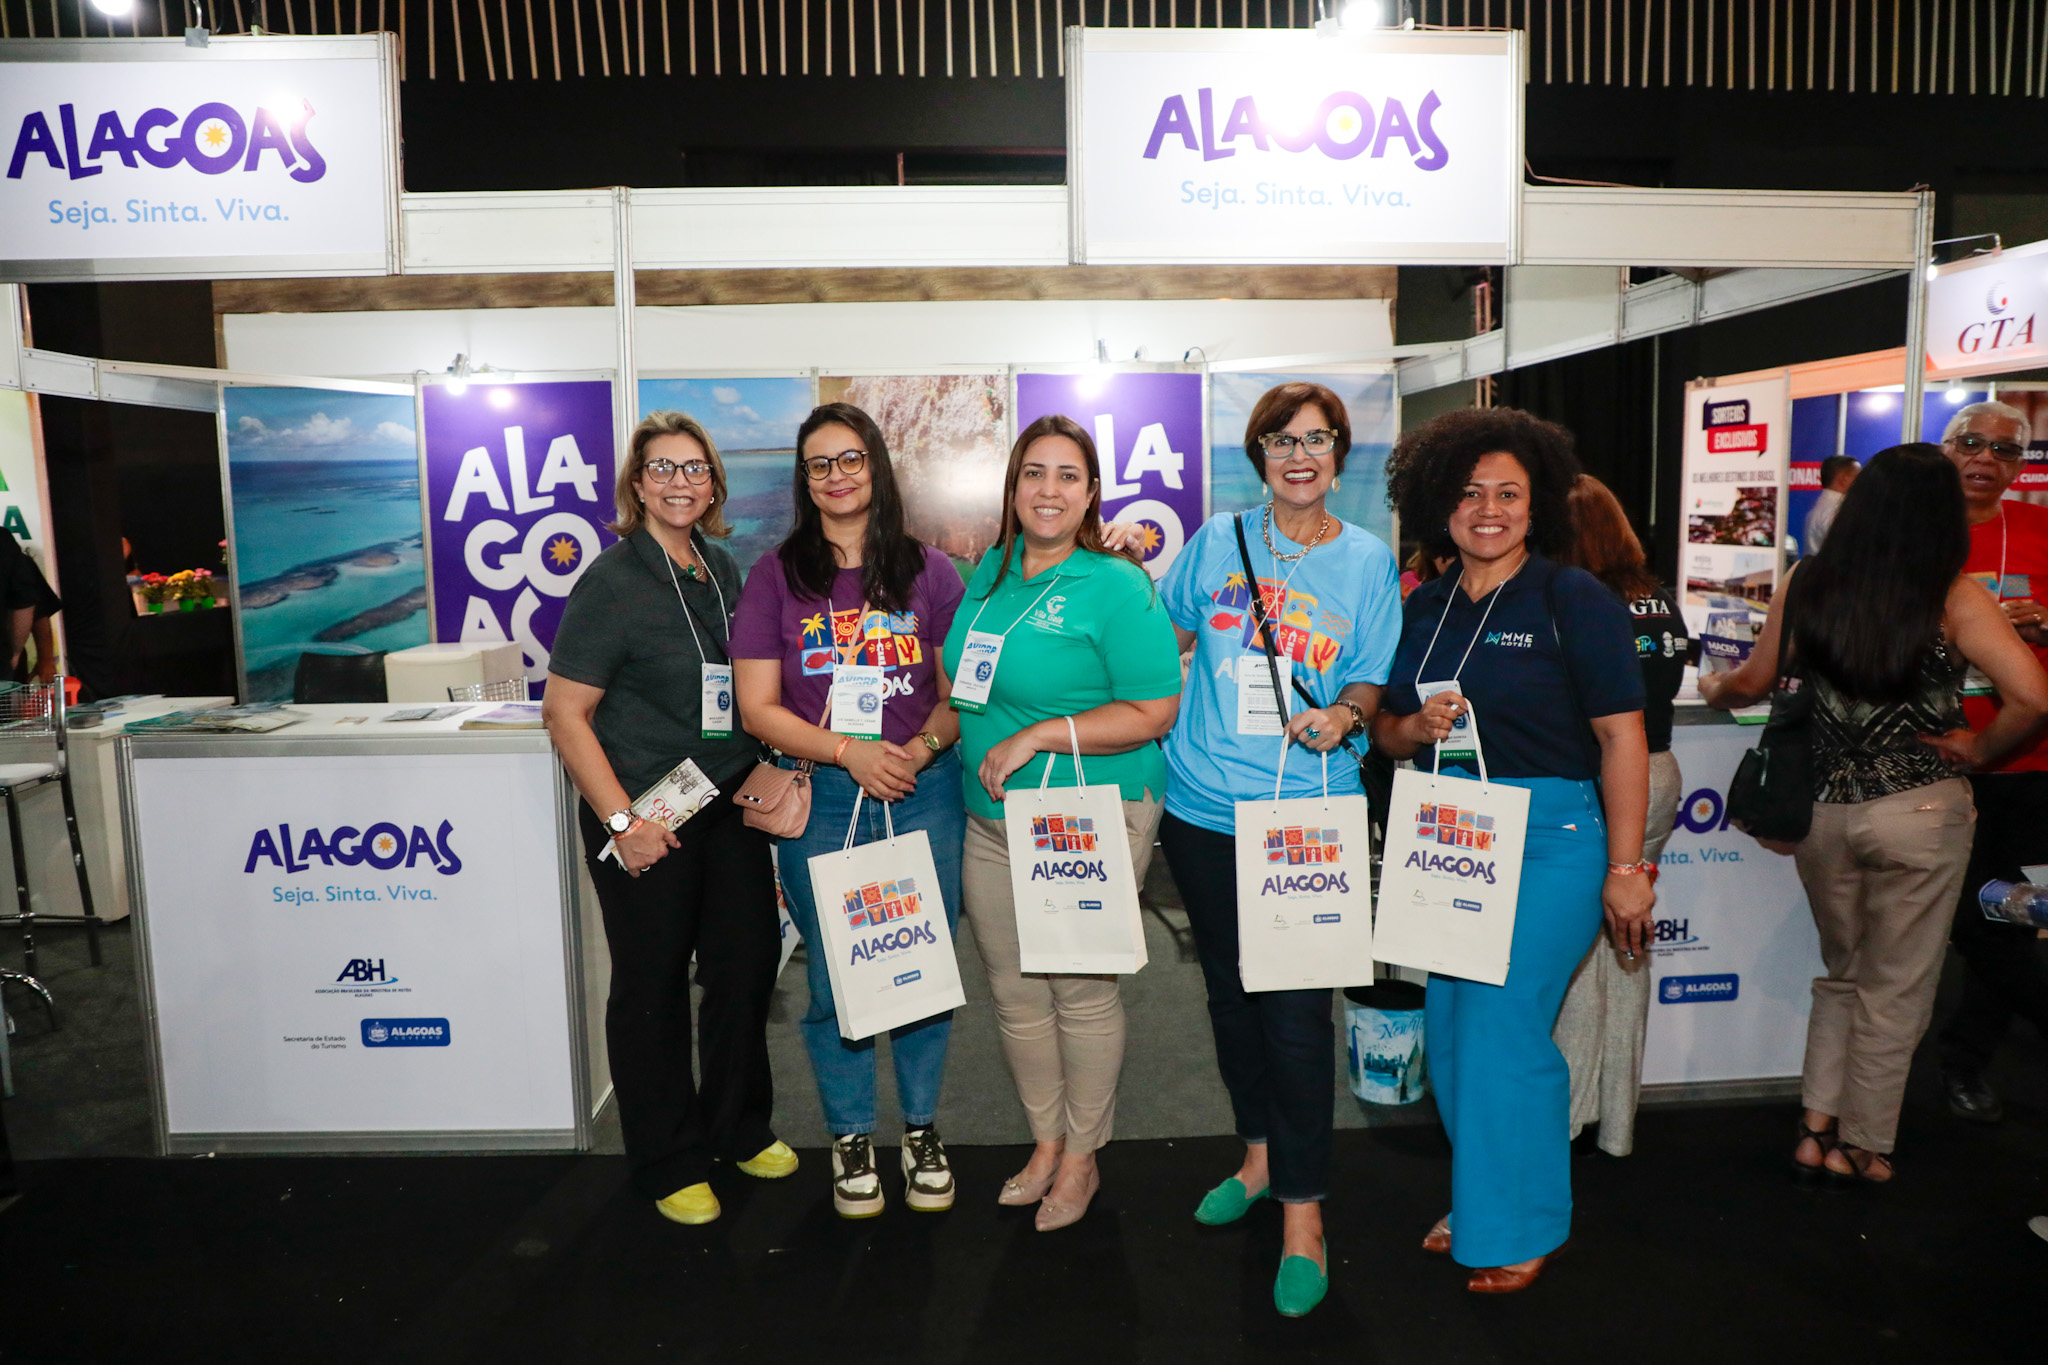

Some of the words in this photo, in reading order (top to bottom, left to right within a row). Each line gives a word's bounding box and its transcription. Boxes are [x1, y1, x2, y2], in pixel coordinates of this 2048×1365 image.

[7, 97, 327, 183] ALAGOAS
[1180, 181, 1246, 210] Seja.
[1255, 182, 1333, 206] Sinta.
[1342, 183, 1411, 208] Viva.
[49, 200, 117, 230] Seja.
[126, 199, 207, 224] Sinta.
[215, 198, 289, 222] Viva.
[1958, 313, 2035, 354] GTA
[1712, 405, 1746, 425] SORTEIOS
[1714, 429, 1757, 450] EXCLUSIVOS
[1094, 414, 1184, 502] LA
[444, 426, 599, 522] ALA
[1788, 468, 1822, 485] ONAIS
[464, 512, 602, 598] GO
[1629, 599, 1671, 615] GTA
[1501, 632, 1534, 644] MME
[244, 819, 462, 876] ALAGOAS
[1658, 850, 1694, 865] nta.
[1699, 848, 1744, 863] Viva.
[1031, 859, 1108, 882] ALAGOAS
[1404, 850, 1496, 885] ALAGOAS
[272, 887, 320, 906] Seja.
[325, 886, 381, 902] Sinta.
[386, 885, 438, 901] Viva.
[1261, 870, 1350, 896] ALAGOAS
[850, 920, 937, 966] ALAGOAS
[1685, 981, 1733, 994] ALAGOAS
[391, 1026, 443, 1036] ALAGOAS
